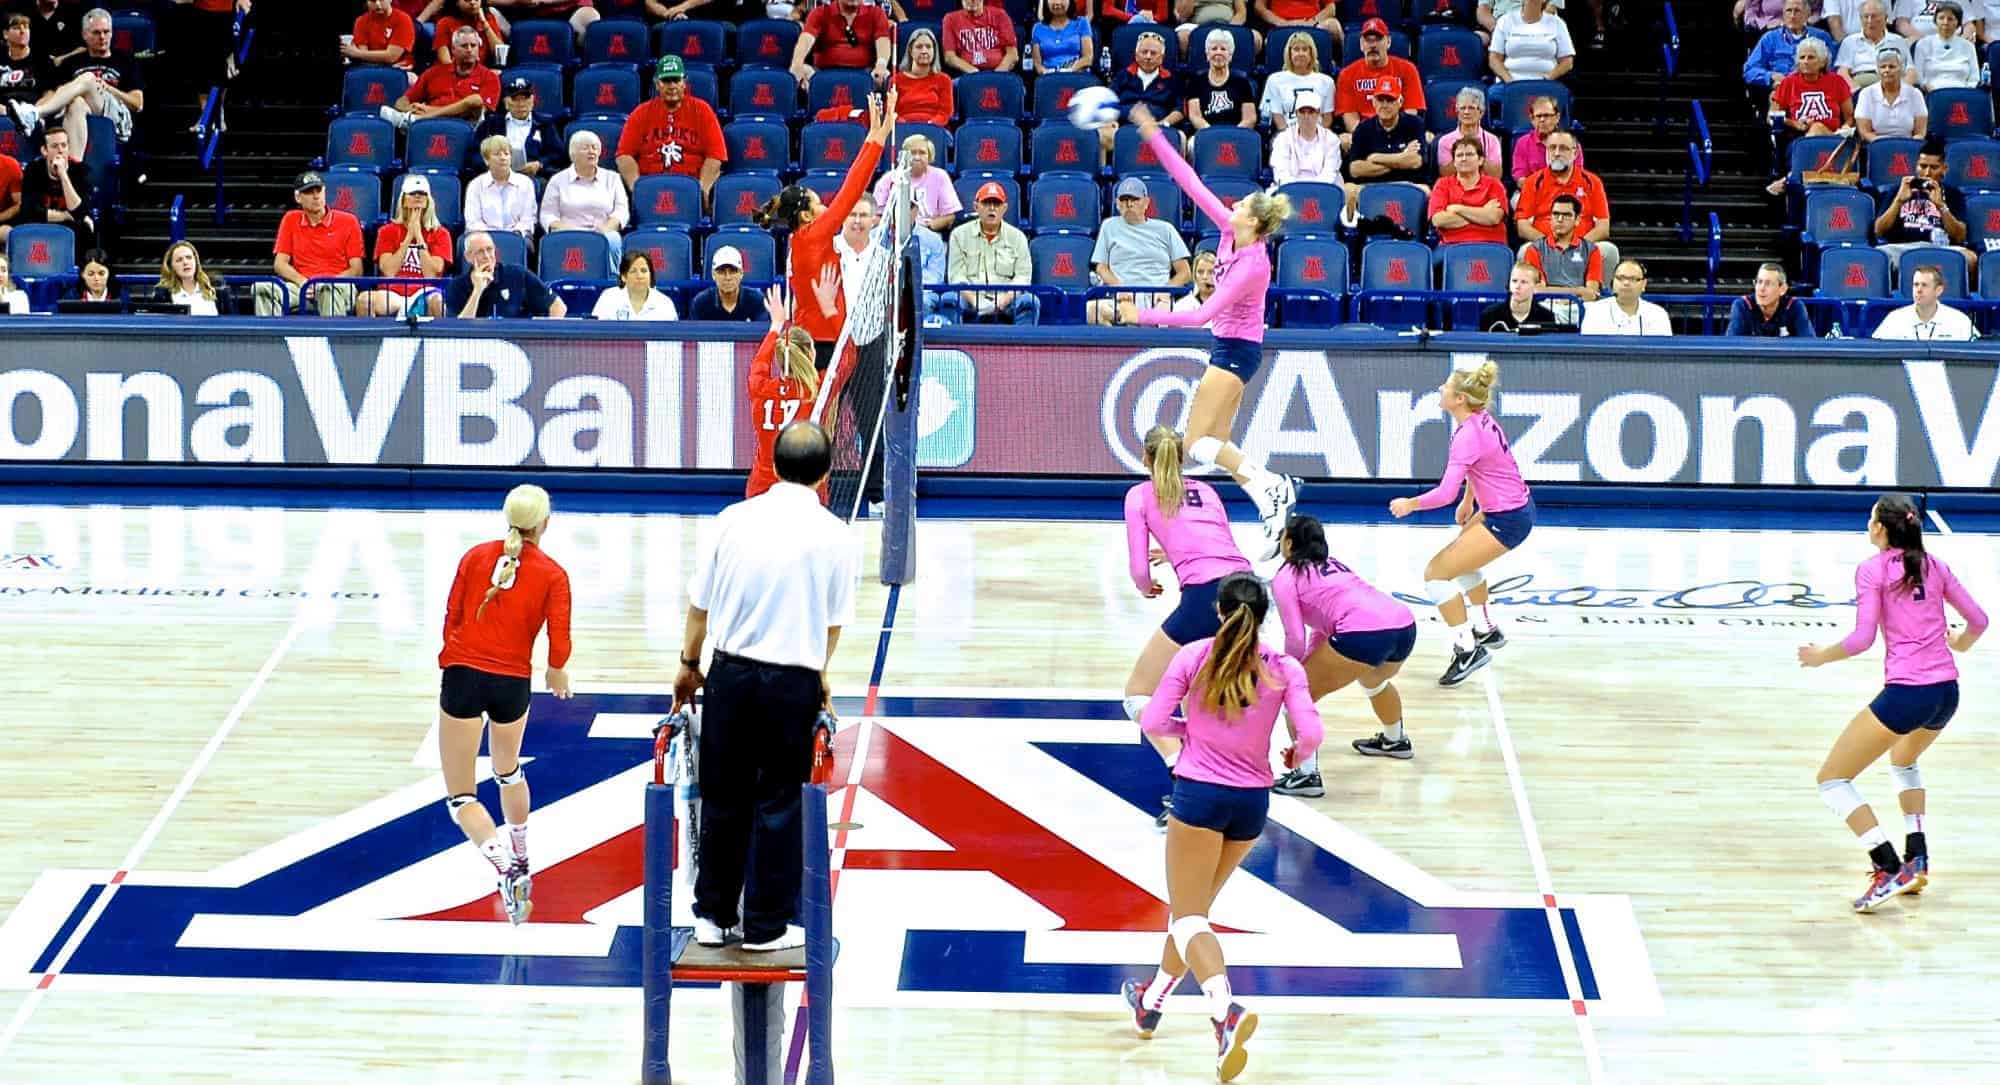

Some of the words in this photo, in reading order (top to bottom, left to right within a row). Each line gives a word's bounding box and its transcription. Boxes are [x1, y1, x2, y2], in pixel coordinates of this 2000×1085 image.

[762, 399, 801, 431] 17
[1101, 347, 2000, 487] @ArzonaV
[51, 585, 227, 599] Medical
